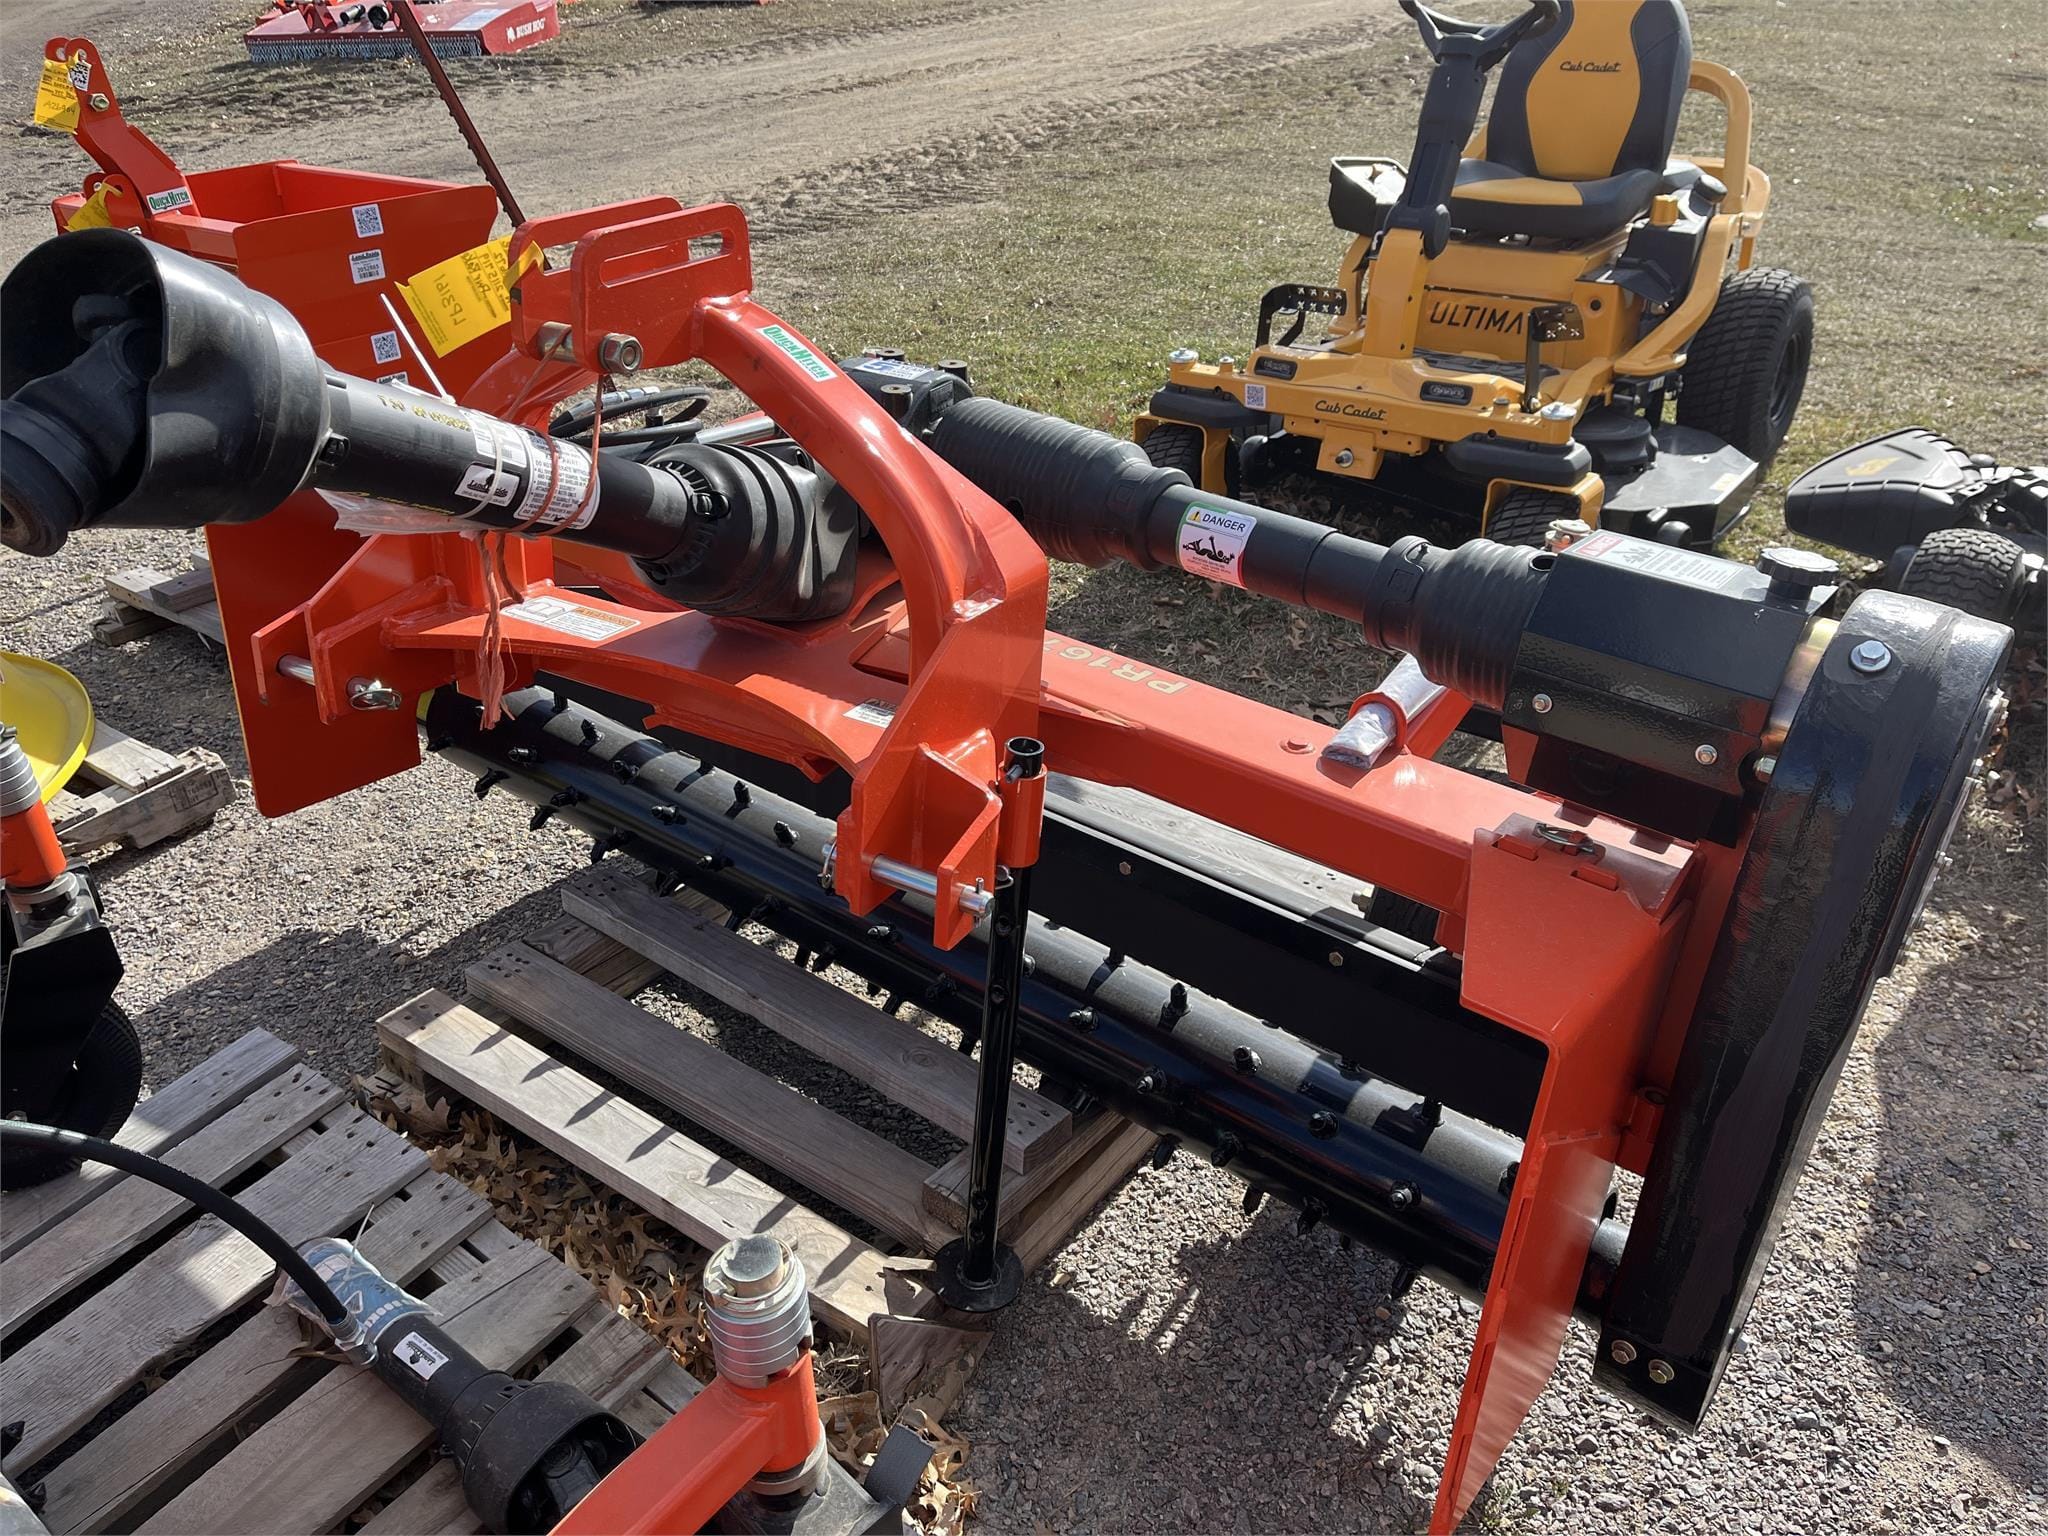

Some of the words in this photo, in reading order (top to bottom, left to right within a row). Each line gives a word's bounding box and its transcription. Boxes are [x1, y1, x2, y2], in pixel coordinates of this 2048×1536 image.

[1559, 60, 1582, 71] Cub
[1583, 61, 1622, 72] Cadet
[1430, 301, 1524, 335] ULTIMA
[1314, 400, 1341, 414] Cub
[1342, 404, 1387, 421] Cadet
[1202, 513, 1247, 533] DANGER
